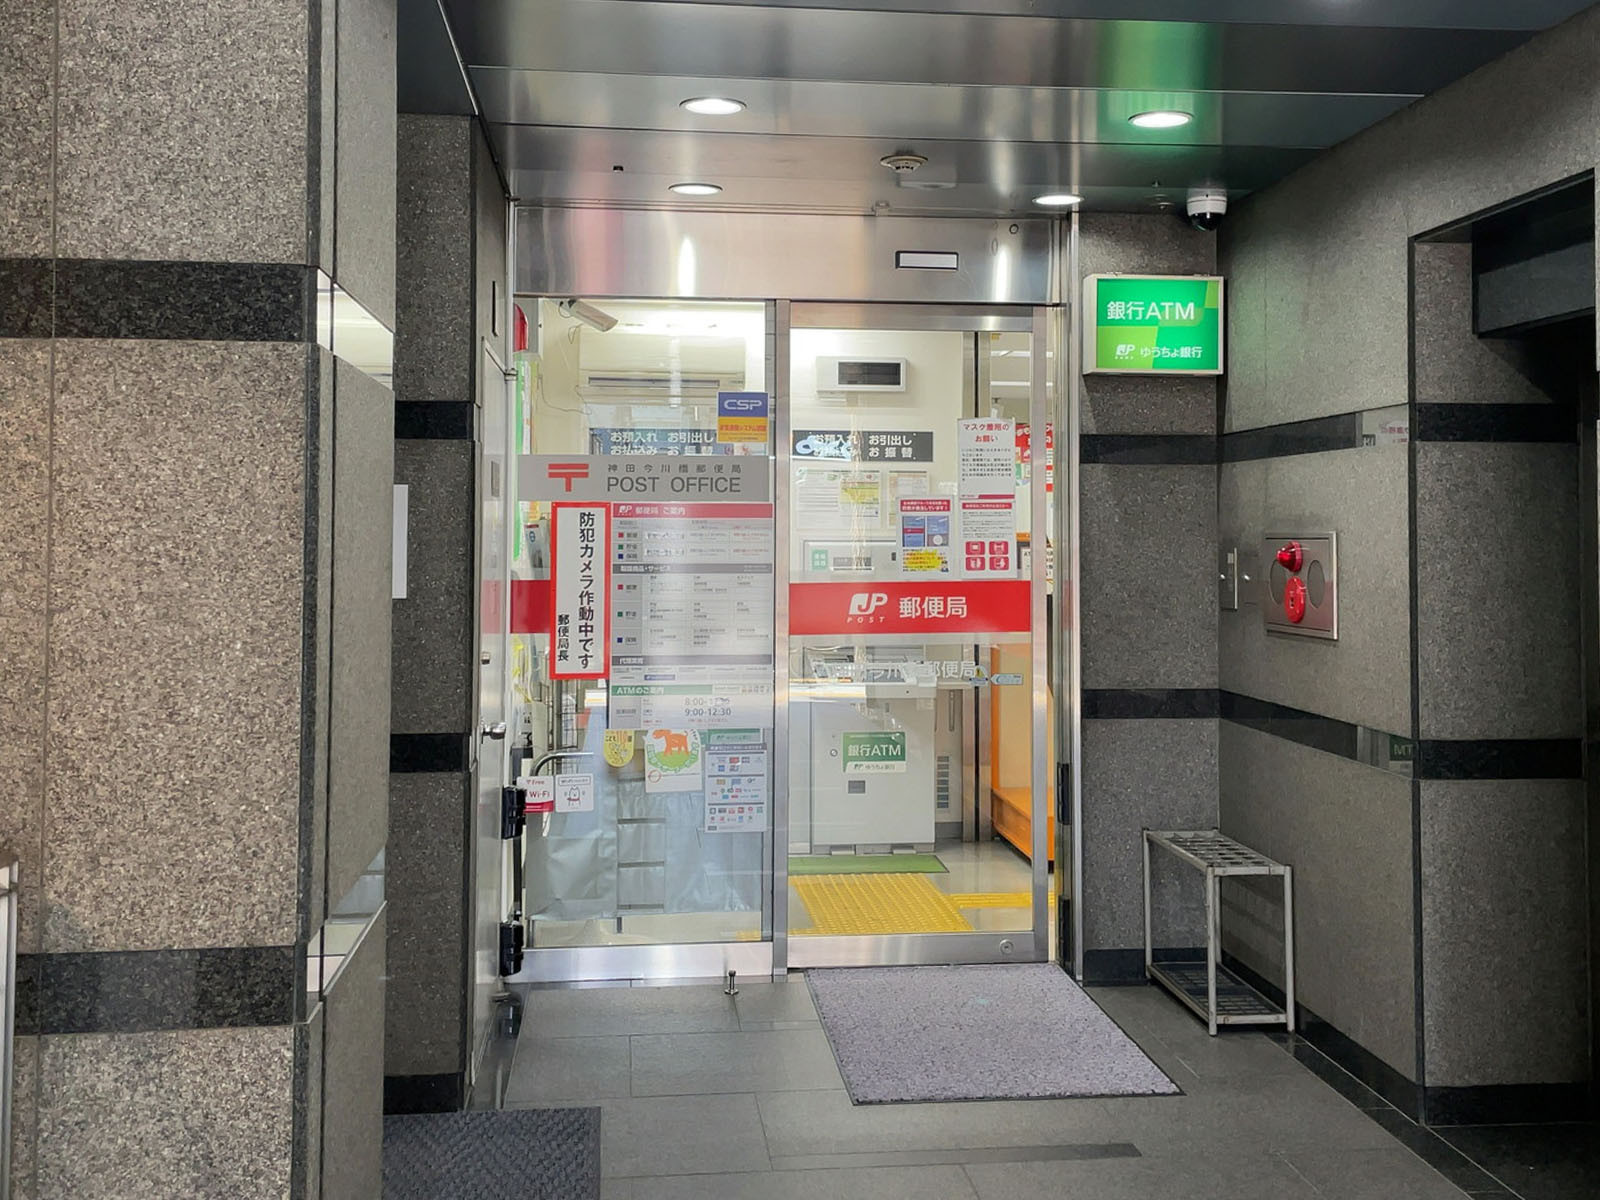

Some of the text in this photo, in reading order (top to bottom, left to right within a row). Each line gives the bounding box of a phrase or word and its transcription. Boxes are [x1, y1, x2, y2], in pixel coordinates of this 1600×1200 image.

[1107, 301, 1195, 320] 銀行ATM
[1140, 346, 1203, 358] ゆうちょ銀行
[724, 399, 762, 410] CSP
[667, 432, 714, 443] お引出し
[868, 434, 913, 446] お引出し
[608, 464, 741, 474] 神田今川橋郵便局
[607, 477, 741, 493] POST OFFICE
[579, 512, 596, 669] 防犯カメラ作動中です
[898, 596, 968, 619] 郵便局
[558, 614, 569, 662] 郵便局長
[685, 708, 731, 716] 9:00-12:30
[848, 744, 901, 757] 銀行ATM
